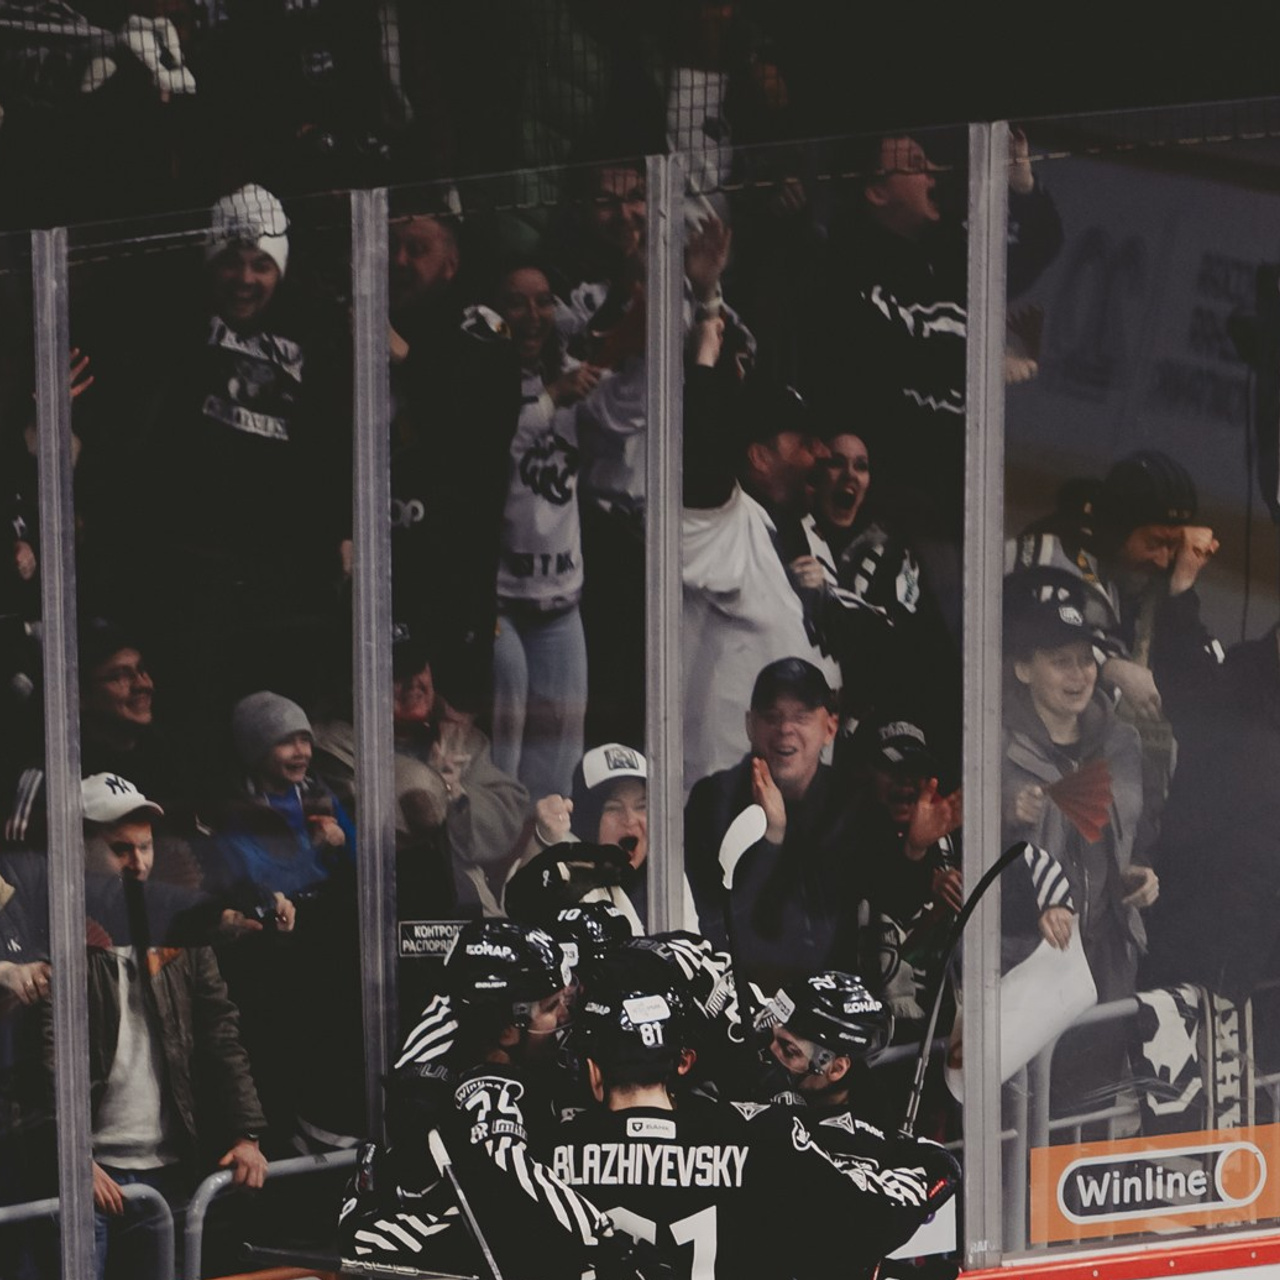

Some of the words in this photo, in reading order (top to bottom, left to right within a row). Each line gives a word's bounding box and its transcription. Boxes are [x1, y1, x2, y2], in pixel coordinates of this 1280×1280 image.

[556, 908, 582, 922] 10
[639, 1021, 665, 1047] 81
[554, 1143, 749, 1187] BLAZHIYEVSKY
[1076, 1165, 1207, 1208] Winline
